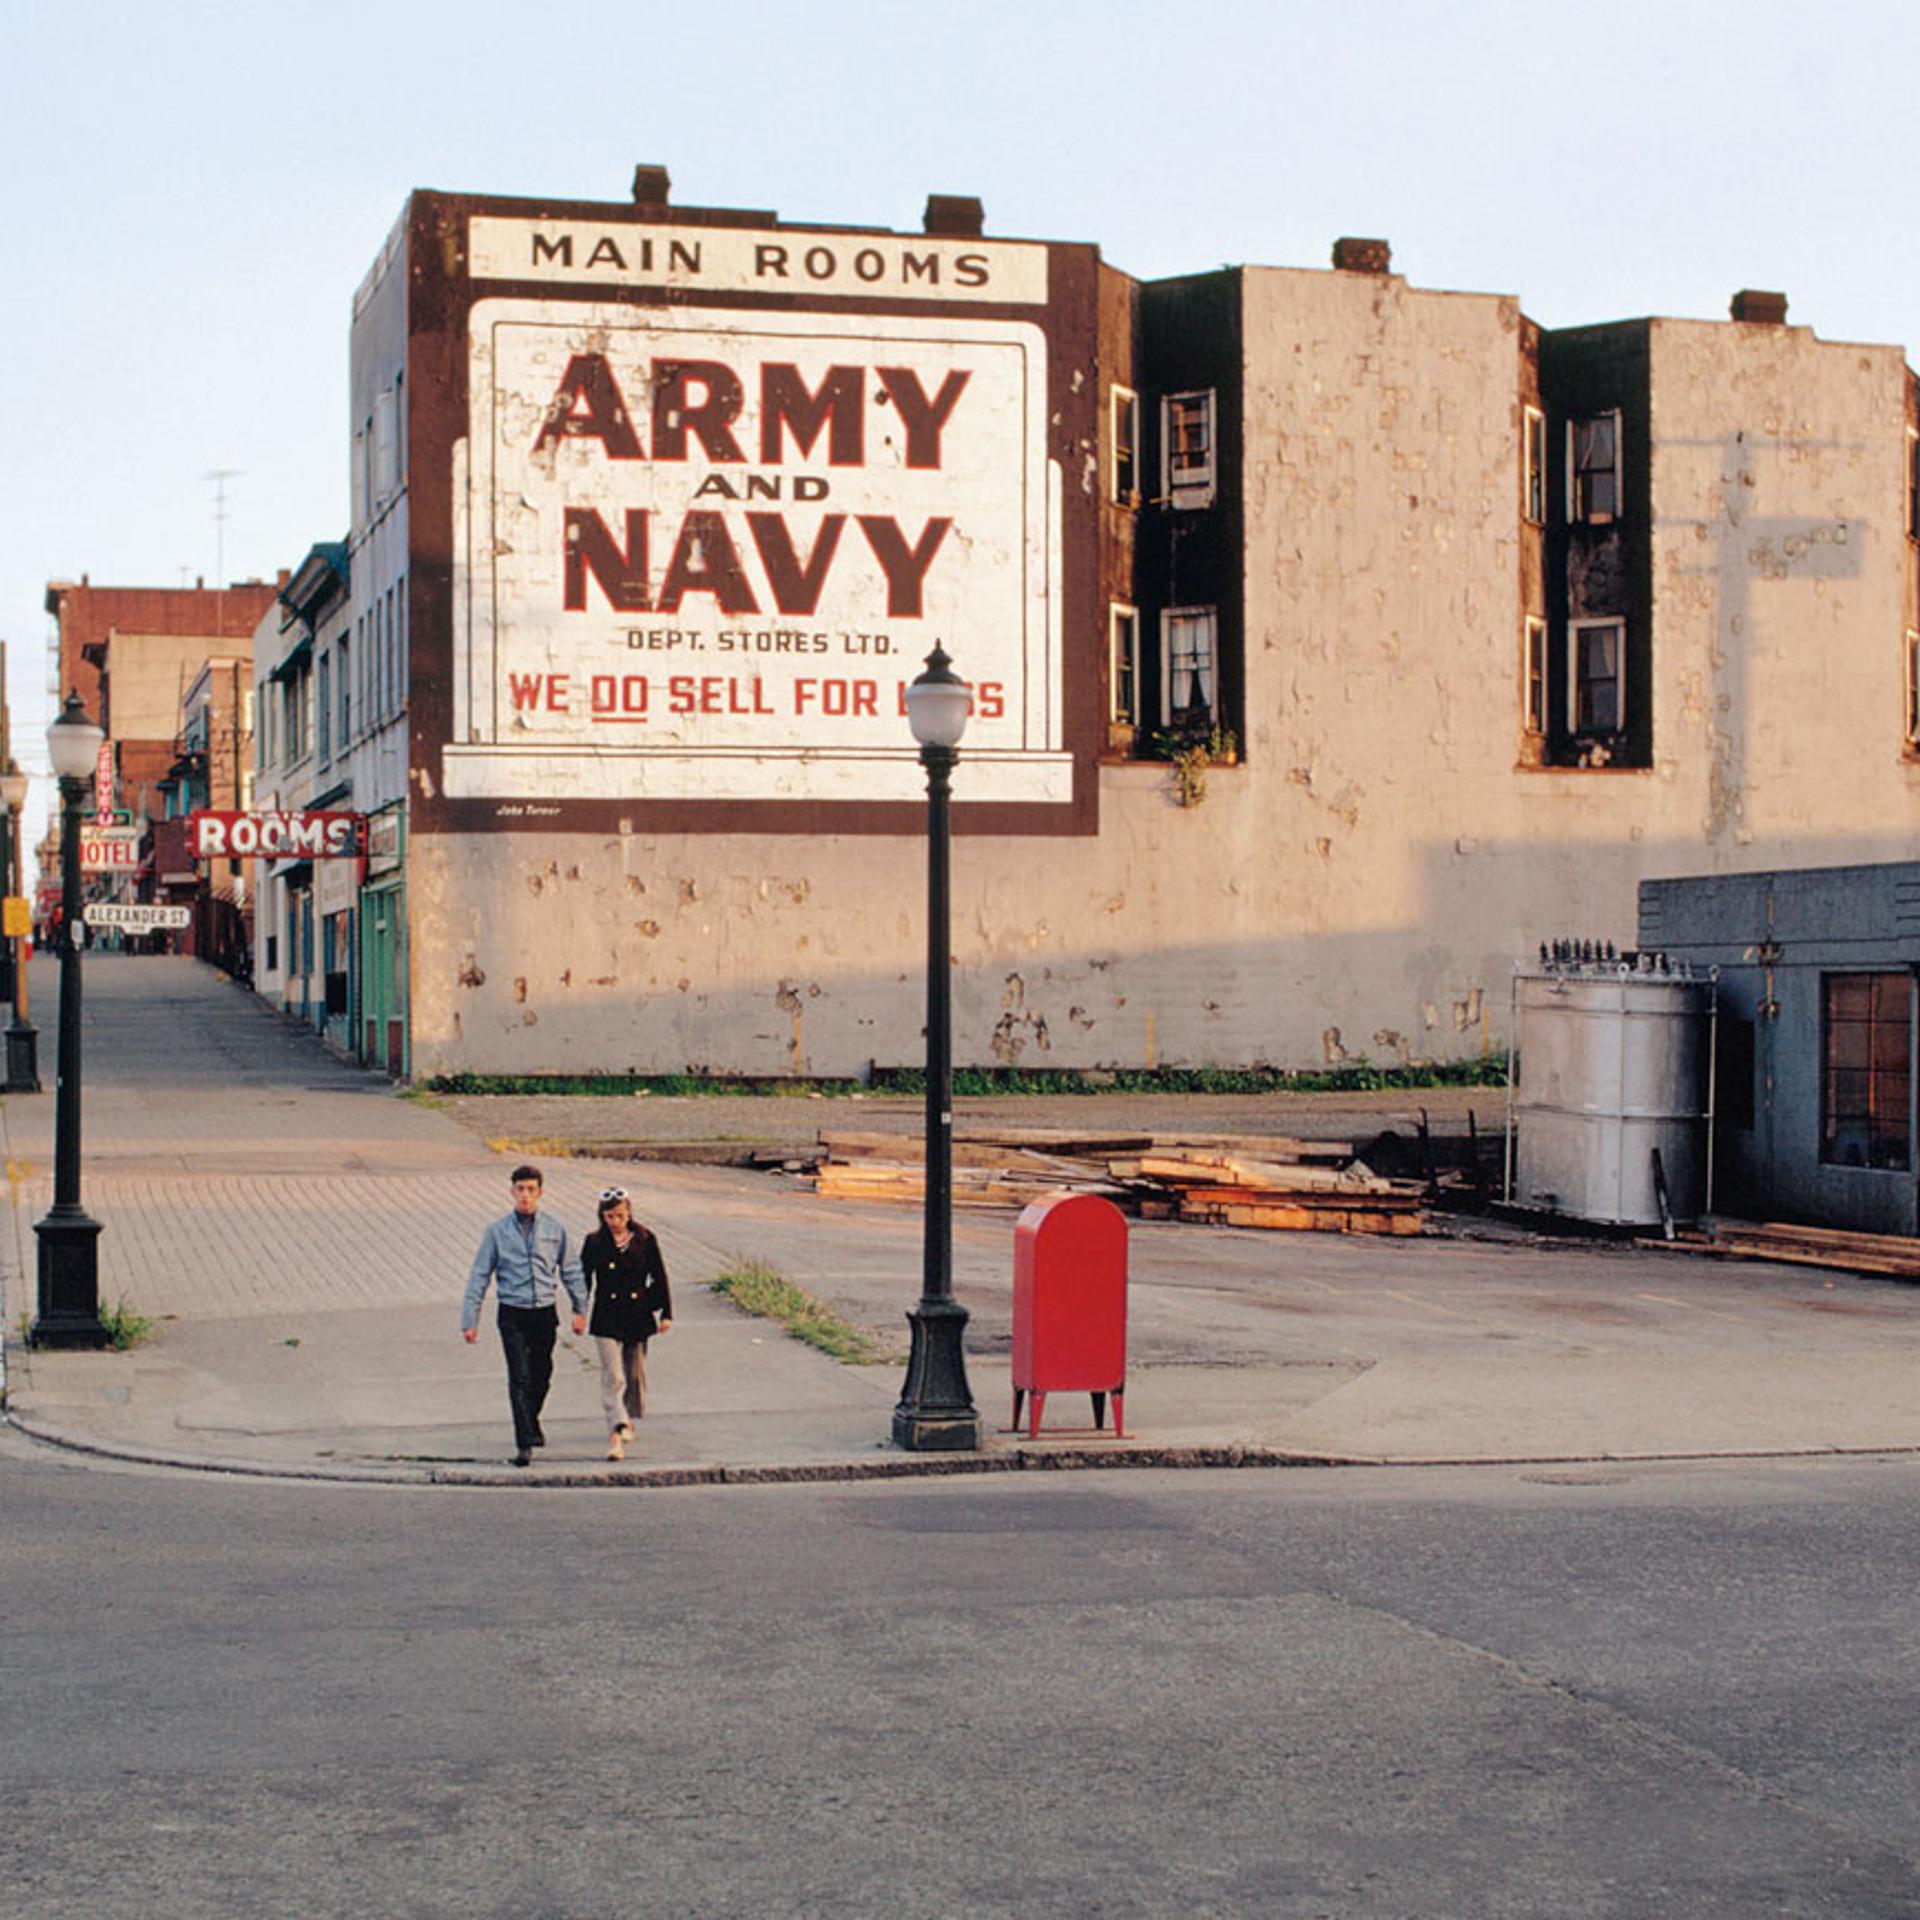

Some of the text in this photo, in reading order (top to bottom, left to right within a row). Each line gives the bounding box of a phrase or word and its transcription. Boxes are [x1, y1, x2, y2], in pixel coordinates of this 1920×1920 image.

[532, 233, 990, 287] MAIN ROOMS
[532, 353, 974, 470] ARMY
[693, 474, 830, 501] AND
[563, 506, 954, 620] NAVY
[627, 630, 900, 655] DEPT. STORES LTD.
[509, 672, 1004, 719] WE DO SELL FOR LS
[199, 817, 352, 855] ROOMS
[89, 907, 167, 924] ALEXANDER
